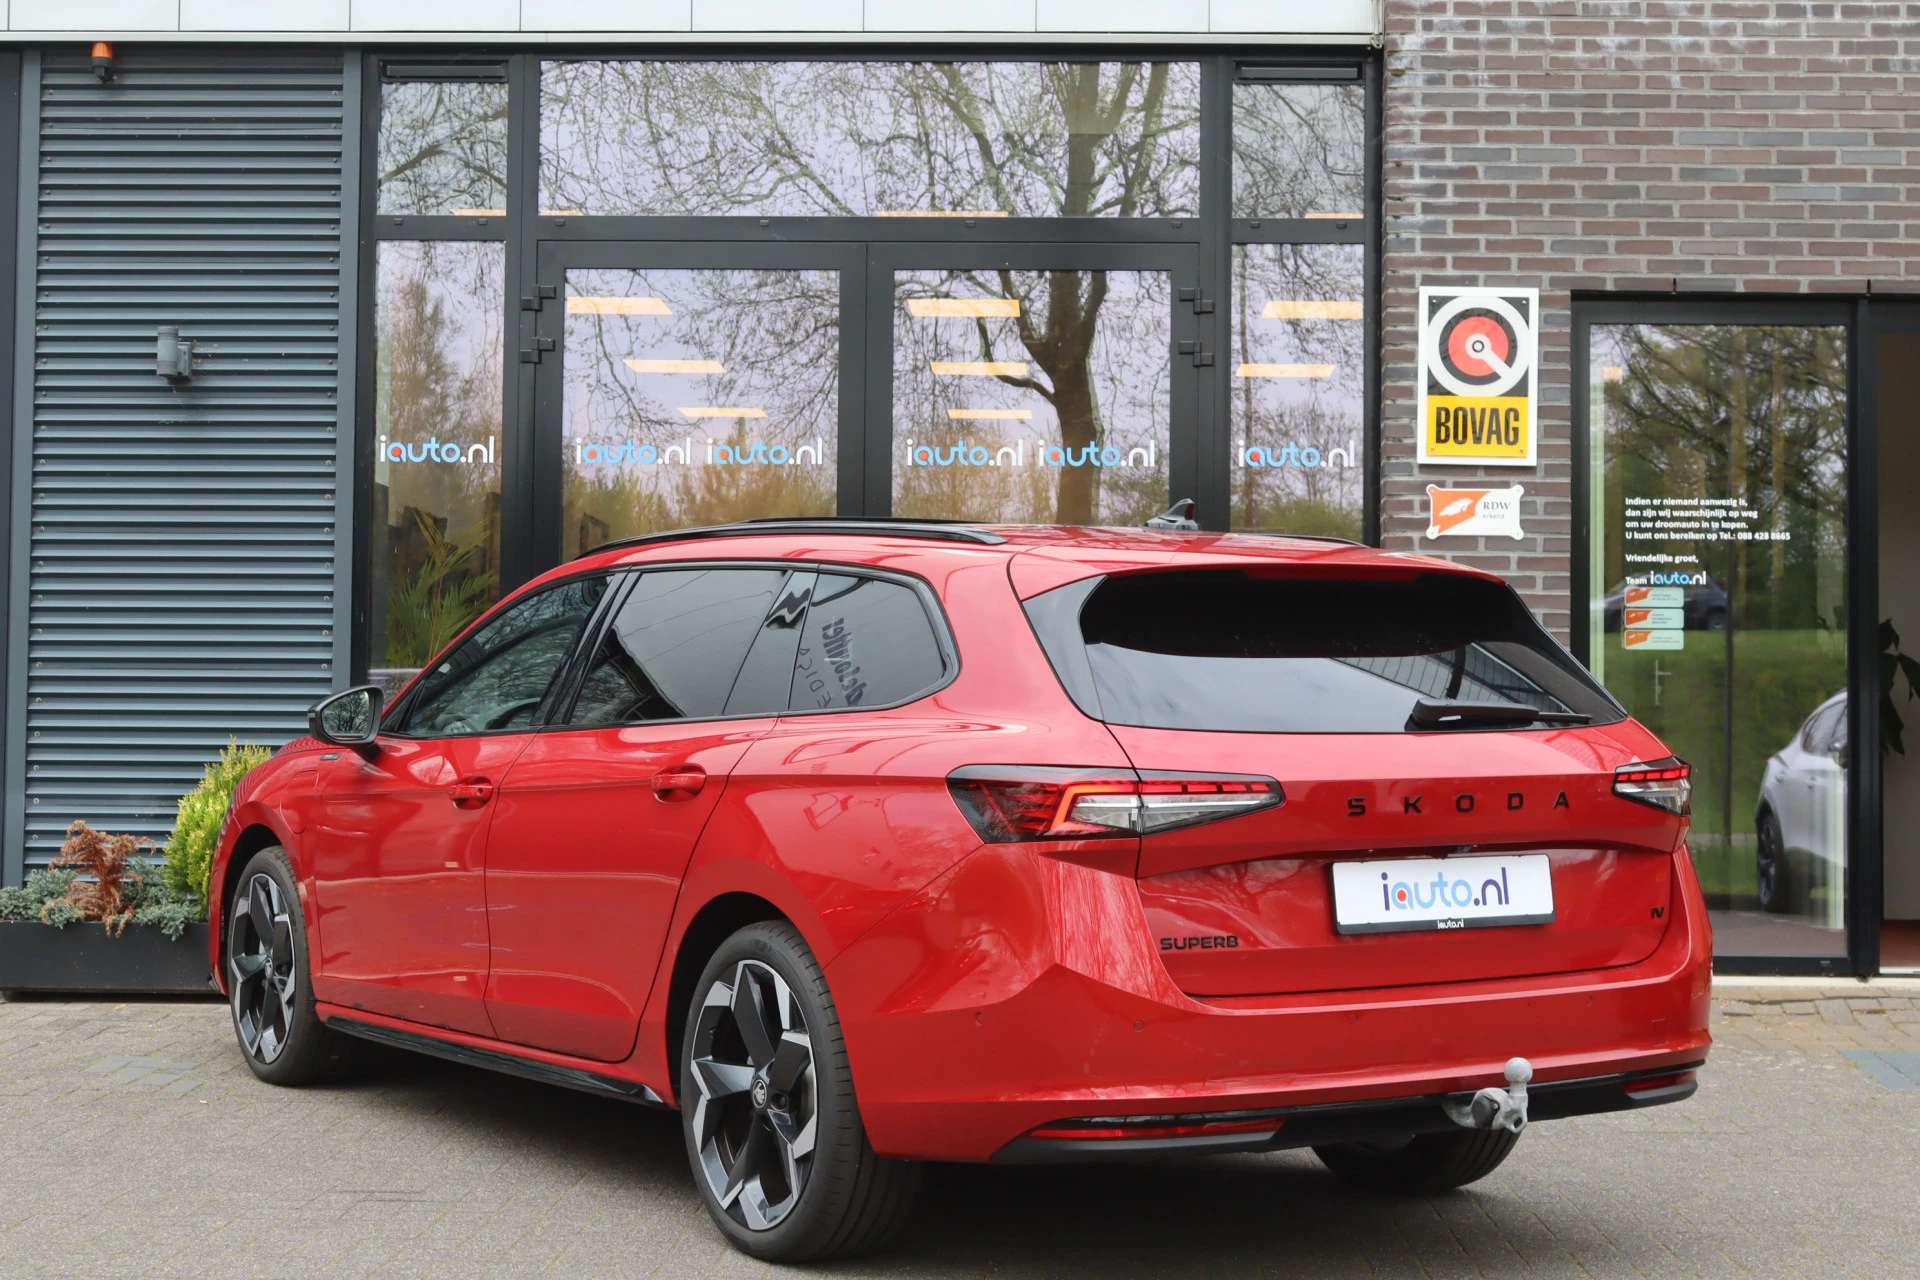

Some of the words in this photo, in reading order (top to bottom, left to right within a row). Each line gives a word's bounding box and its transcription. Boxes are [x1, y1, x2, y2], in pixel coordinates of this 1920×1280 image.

[1435, 406, 1520, 447] BOVAG
[379, 435, 494, 464] iauto.nl
[575, 437, 691, 466] iauto.nl
[706, 437, 823, 466] iauto.nl
[906, 438, 1023, 467] iauto.nl
[1038, 439, 1155, 467] iauto.nl
[1238, 439, 1355, 468] iauto.nl
[1483, 501, 1511, 510] RDW
[1625, 497, 1651, 506] Indien
[1663, 497, 1699, 506] niemand
[1699, 497, 1738, 508] aanwezig
[1739, 497, 1748, 507] is,
[1625, 508, 1641, 517] dan
[1642, 508, 1657, 519] zijn
[1658, 508, 1671, 519] wij
[1672, 508, 1727, 519] waarschijnlijk
[1728, 510, 1740, 519] op
[1741, 510, 1759, 519] weg
[1625, 531, 1632, 540] U
[1633, 531, 1653, 540] kunt
[1653, 532, 1669, 540] ons
[1670, 531, 1705, 540] bereiken
[1706, 533, 1718, 541] op
[1654, 520, 1700, 528] droomauto
[1701, 520, 1710, 528] in
[1721, 520, 1749, 530] kopen.
[1625, 553, 1673, 564] Vriendelijke
[1674, 554, 1699, 564] groet,
[1625, 576, 1648, 585] Team
[1650, 570, 1707, 585] iauto.nl
[1347, 791, 1570, 817] SKODA
[1380, 866, 1511, 912] iauto.nl
[1160, 935, 1239, 951] SUPERB
